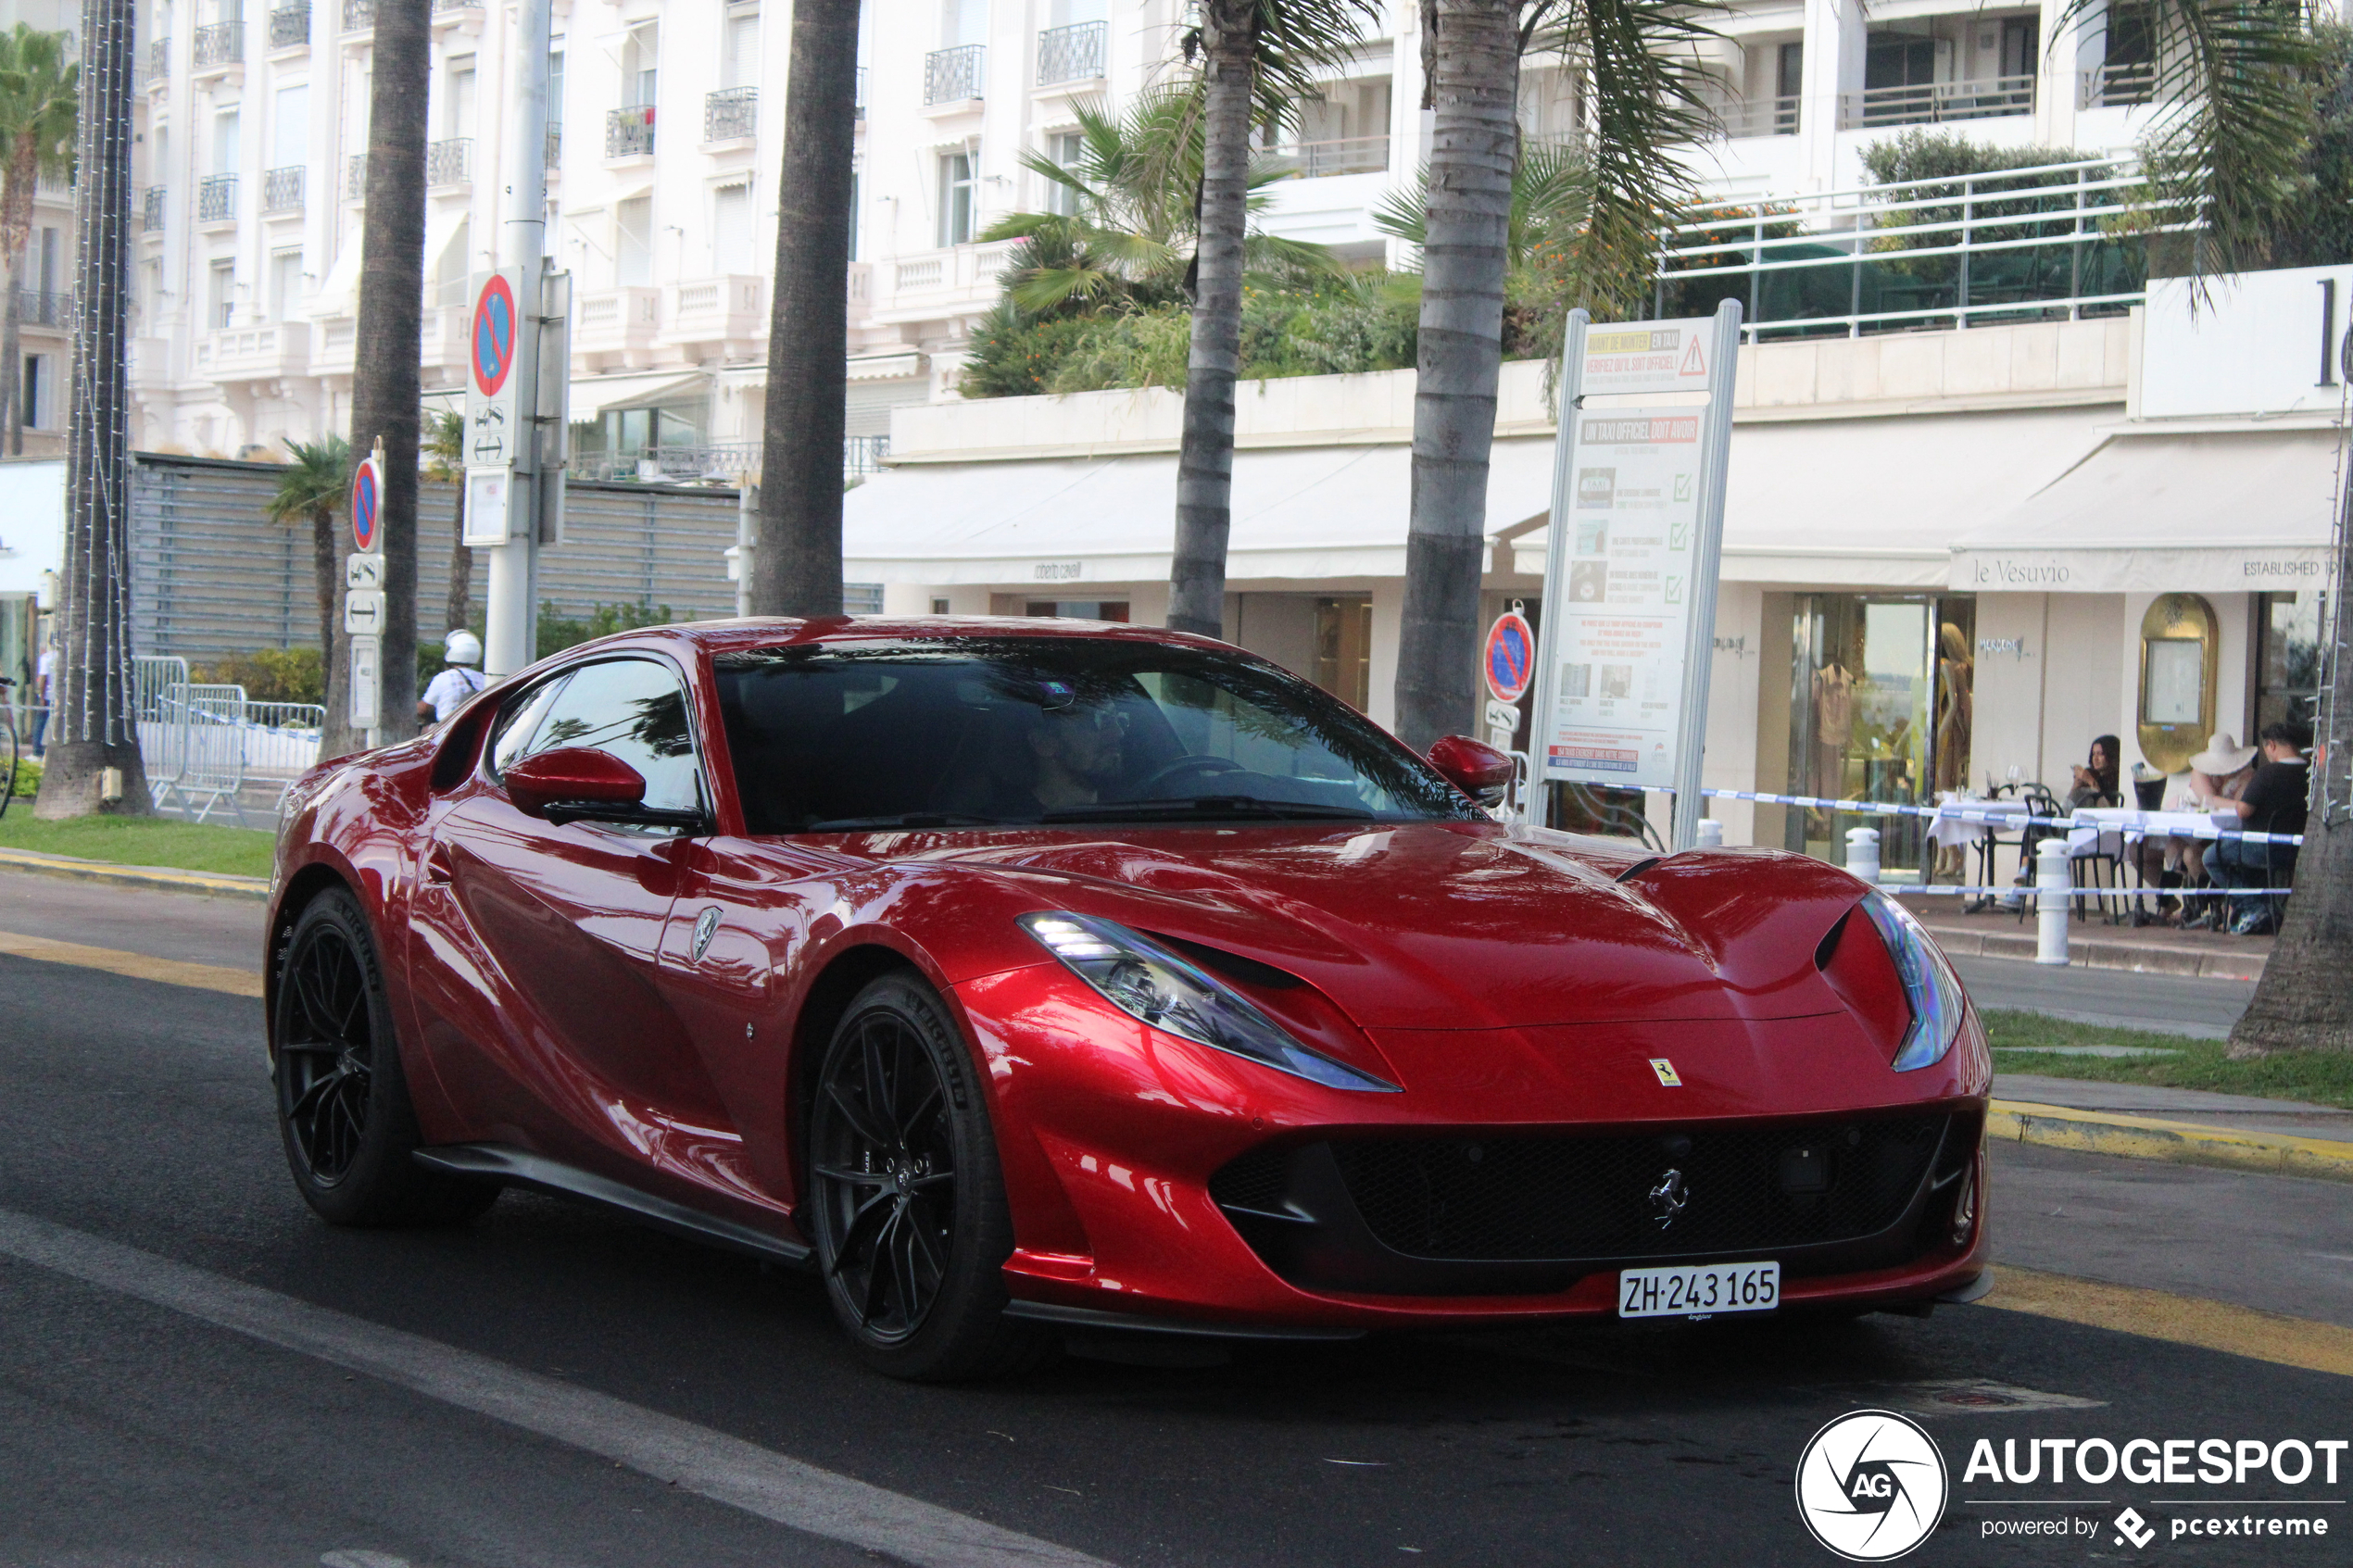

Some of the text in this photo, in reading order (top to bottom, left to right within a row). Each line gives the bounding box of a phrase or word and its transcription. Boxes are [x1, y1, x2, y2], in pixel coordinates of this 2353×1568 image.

[1588, 332, 1680, 352] AVANT DE MONTER EN TAXI
[1586, 358, 1614, 373] VÉRIFIEZ
[1614, 358, 1629, 372] QU'IL
[1631, 356, 1646, 371] SOIT
[1646, 355, 1674, 370] OFFICIEL
[1585, 420, 1696, 441] UN TAXI OFFICIEL DOIT AVOIR
[1975, 558, 2070, 583] le Vesuvio
[2244, 561, 2320, 576] ESTABLISHED
